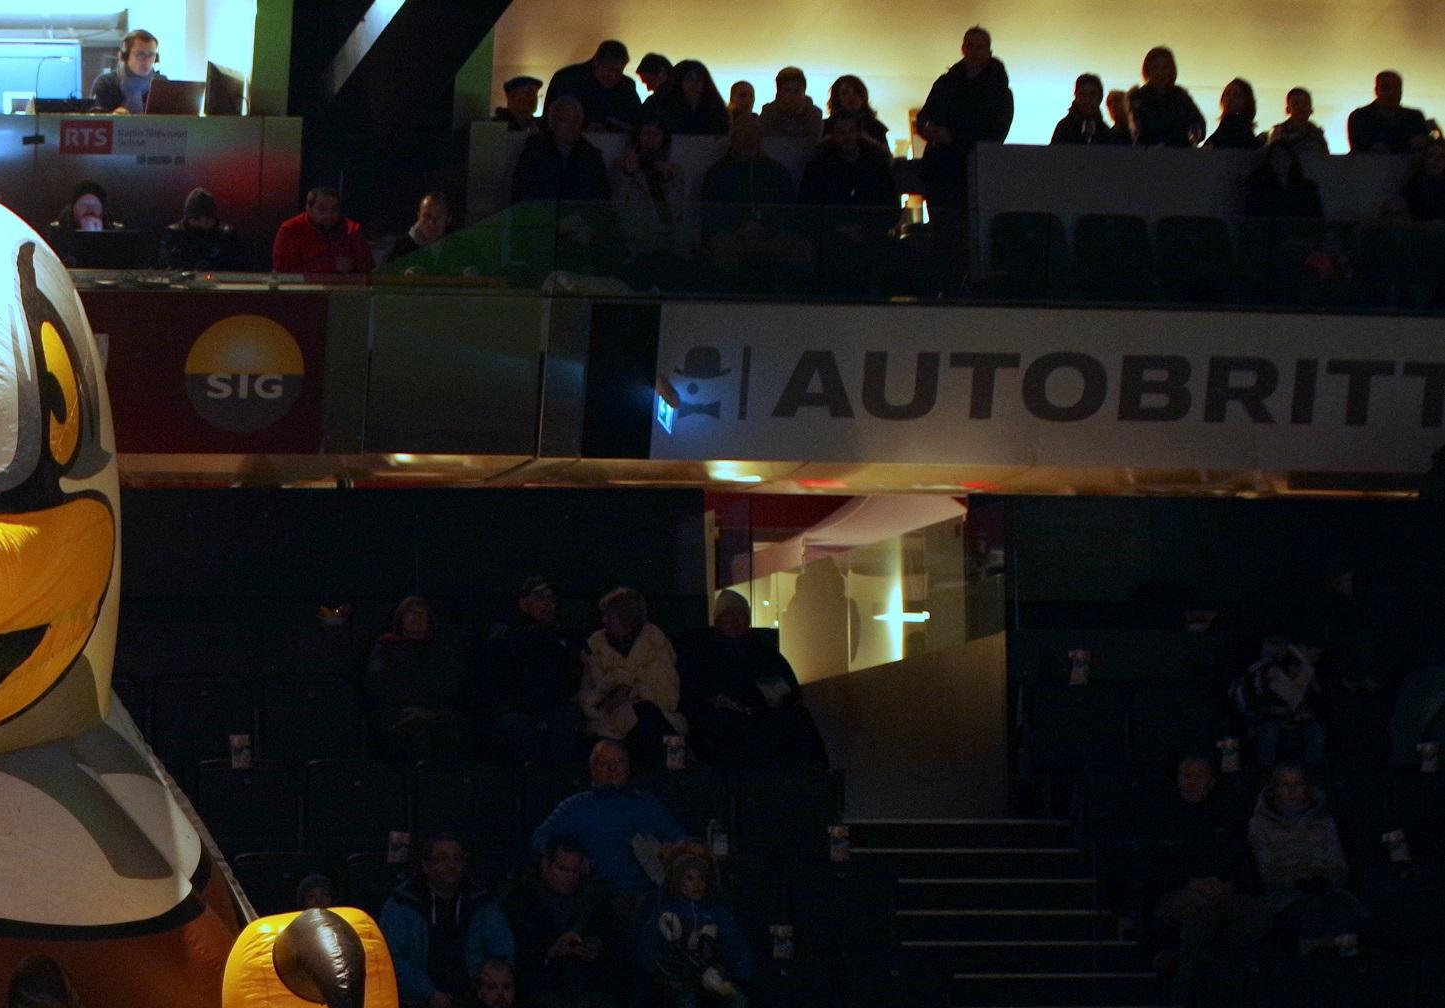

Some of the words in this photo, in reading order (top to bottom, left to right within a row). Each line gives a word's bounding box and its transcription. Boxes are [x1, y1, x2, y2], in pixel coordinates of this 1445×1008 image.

[65, 127, 108, 147] RTS
[206, 372, 284, 400] SIG
[771, 350, 1445, 428] AUTOBRITT
